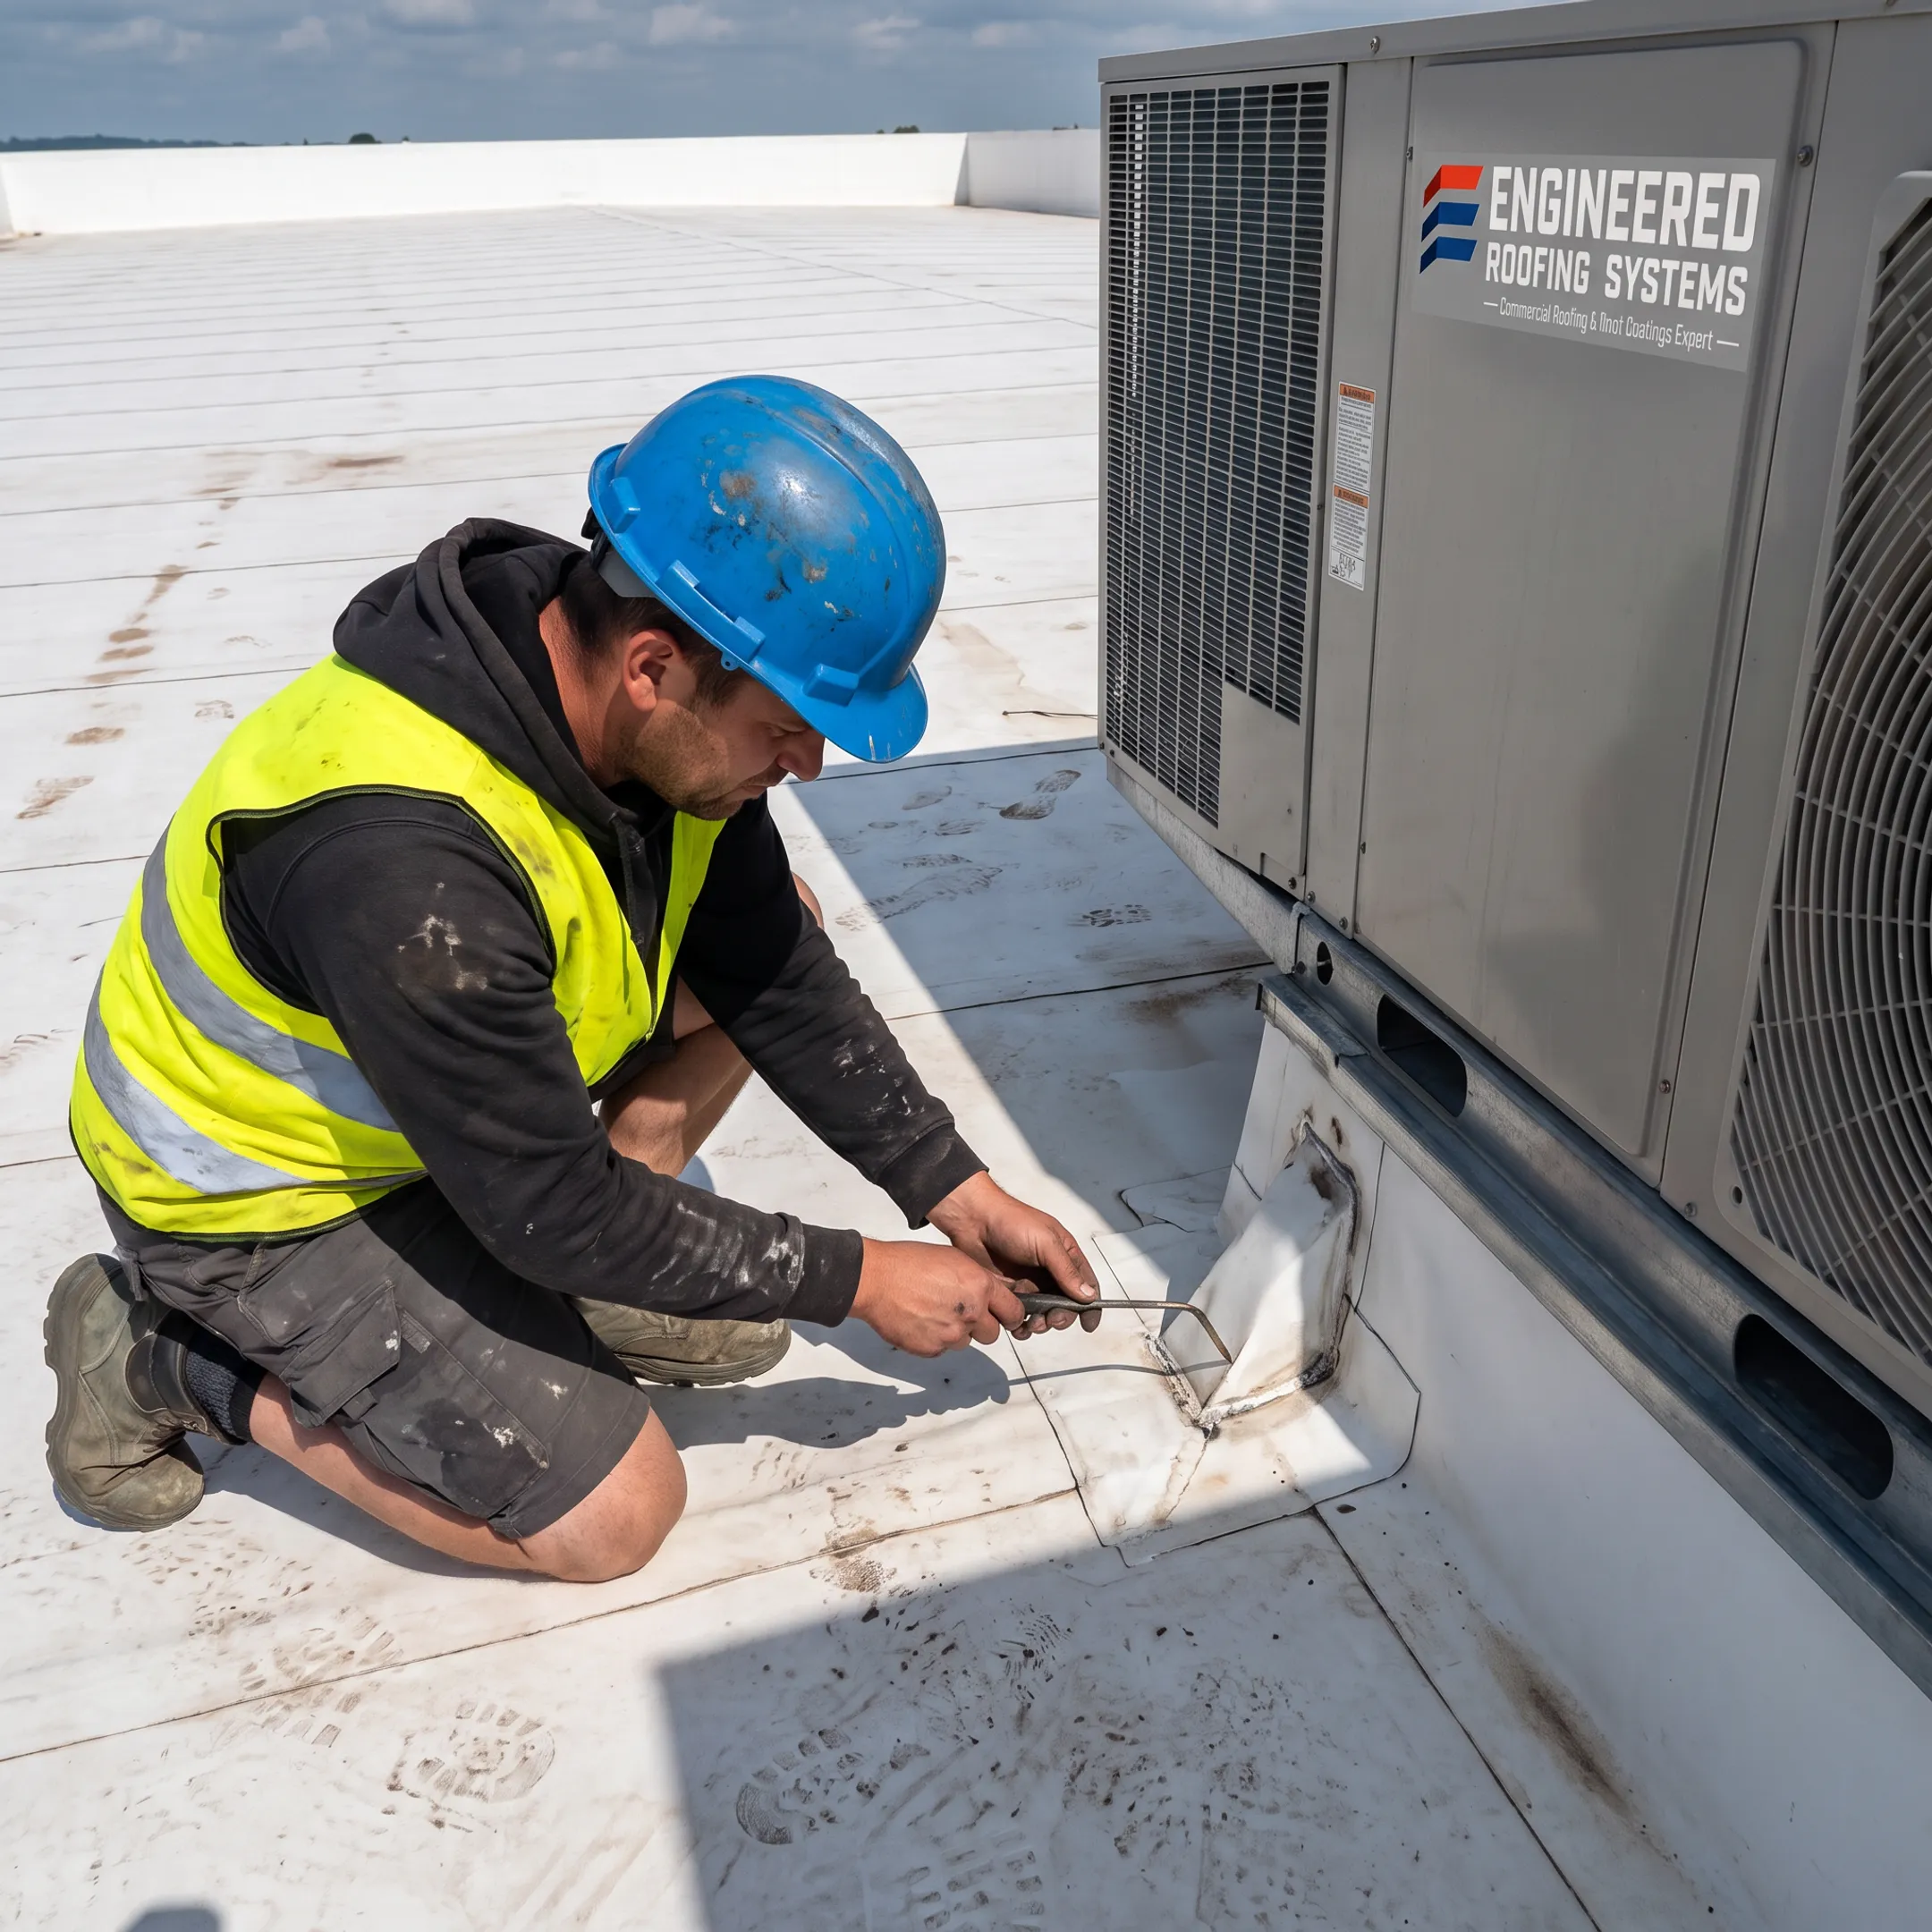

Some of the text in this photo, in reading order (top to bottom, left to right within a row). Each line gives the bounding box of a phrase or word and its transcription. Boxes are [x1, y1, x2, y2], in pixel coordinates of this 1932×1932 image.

[1488, 165, 1761, 252] ENGINEERED
[1485, 242, 1749, 317] ROOFING SYSTEMS
[1499, 296, 1552, 323] Commercial
[1552, 304, 1589, 335] Roofing
[1589, 310, 1597, 332] &
[1625, 316, 1673, 348] Coatings
[1674, 323, 1714, 352] Expert
